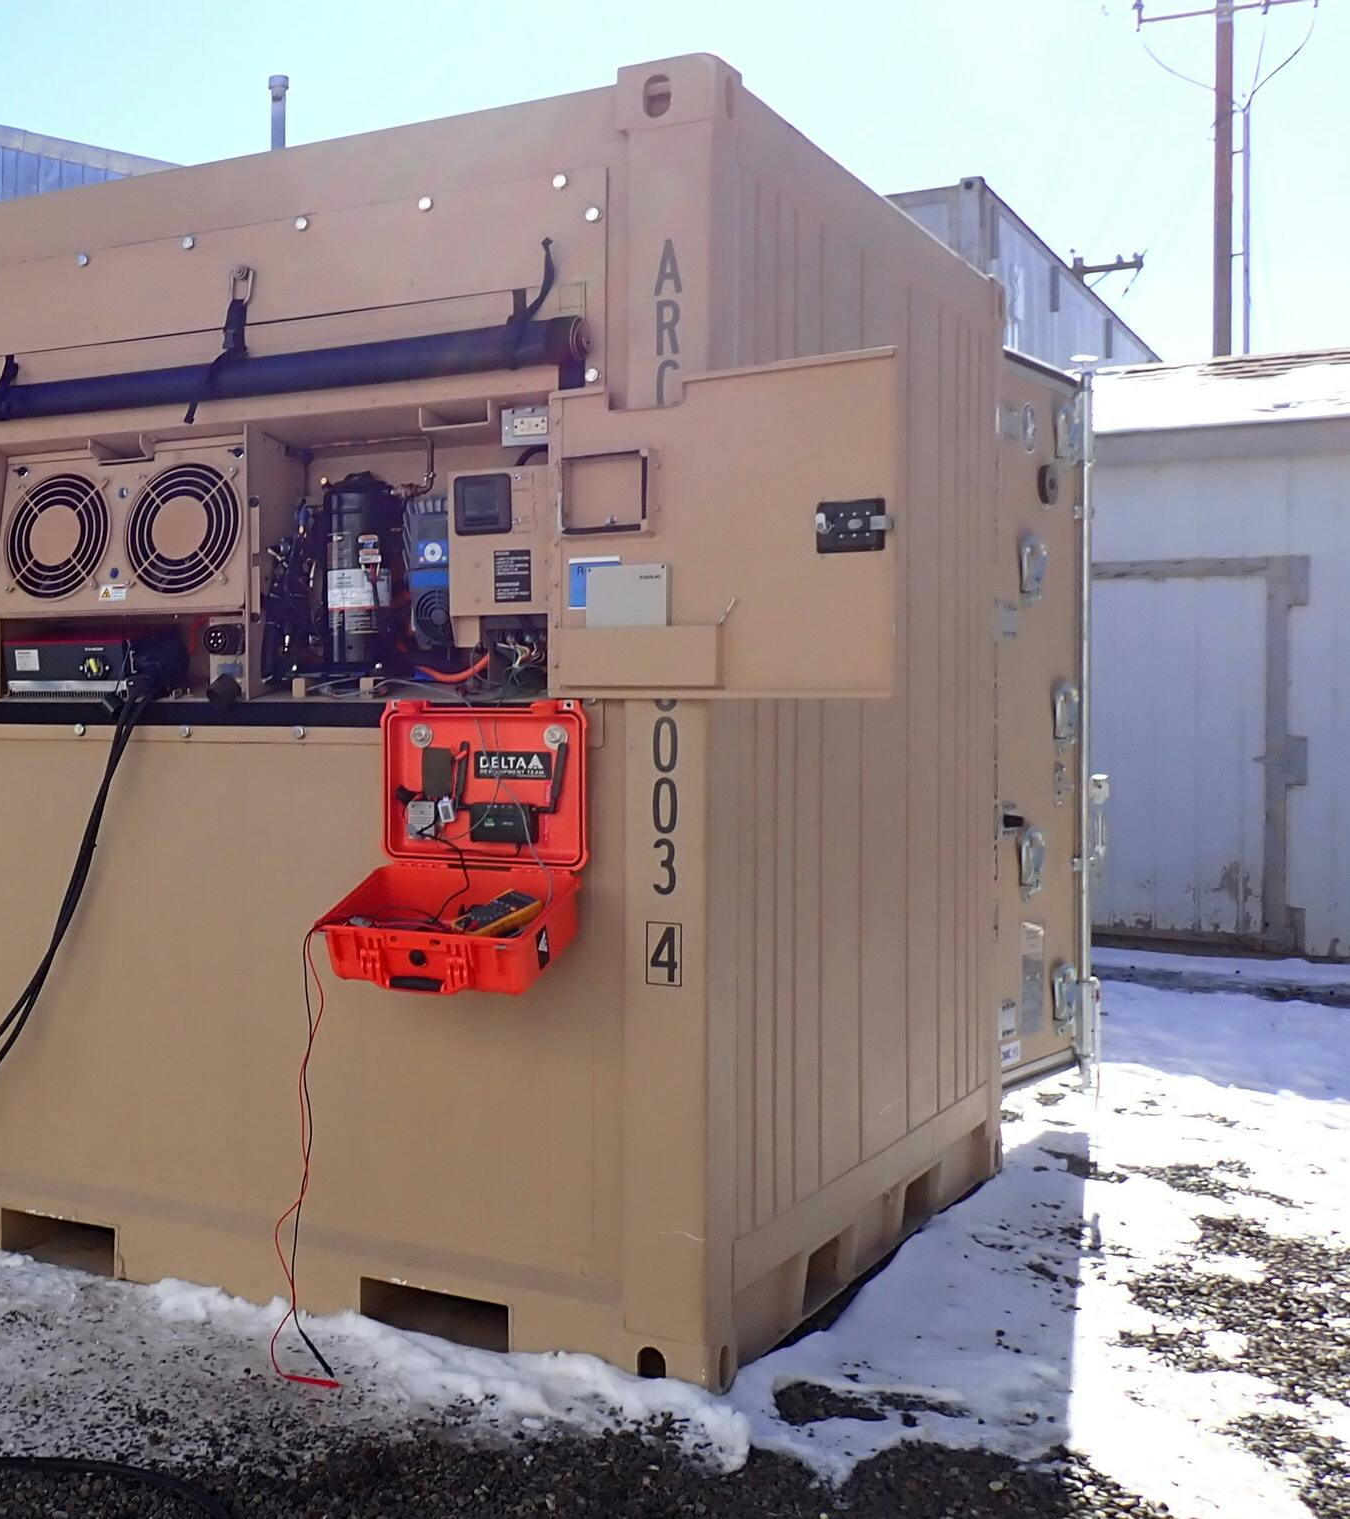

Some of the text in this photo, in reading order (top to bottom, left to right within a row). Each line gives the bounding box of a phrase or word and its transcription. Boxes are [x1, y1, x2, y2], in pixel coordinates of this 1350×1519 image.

[479, 756, 527, 769] DELTA
[652, 698, 678, 896] 003
[650, 926, 678, 983] 4
